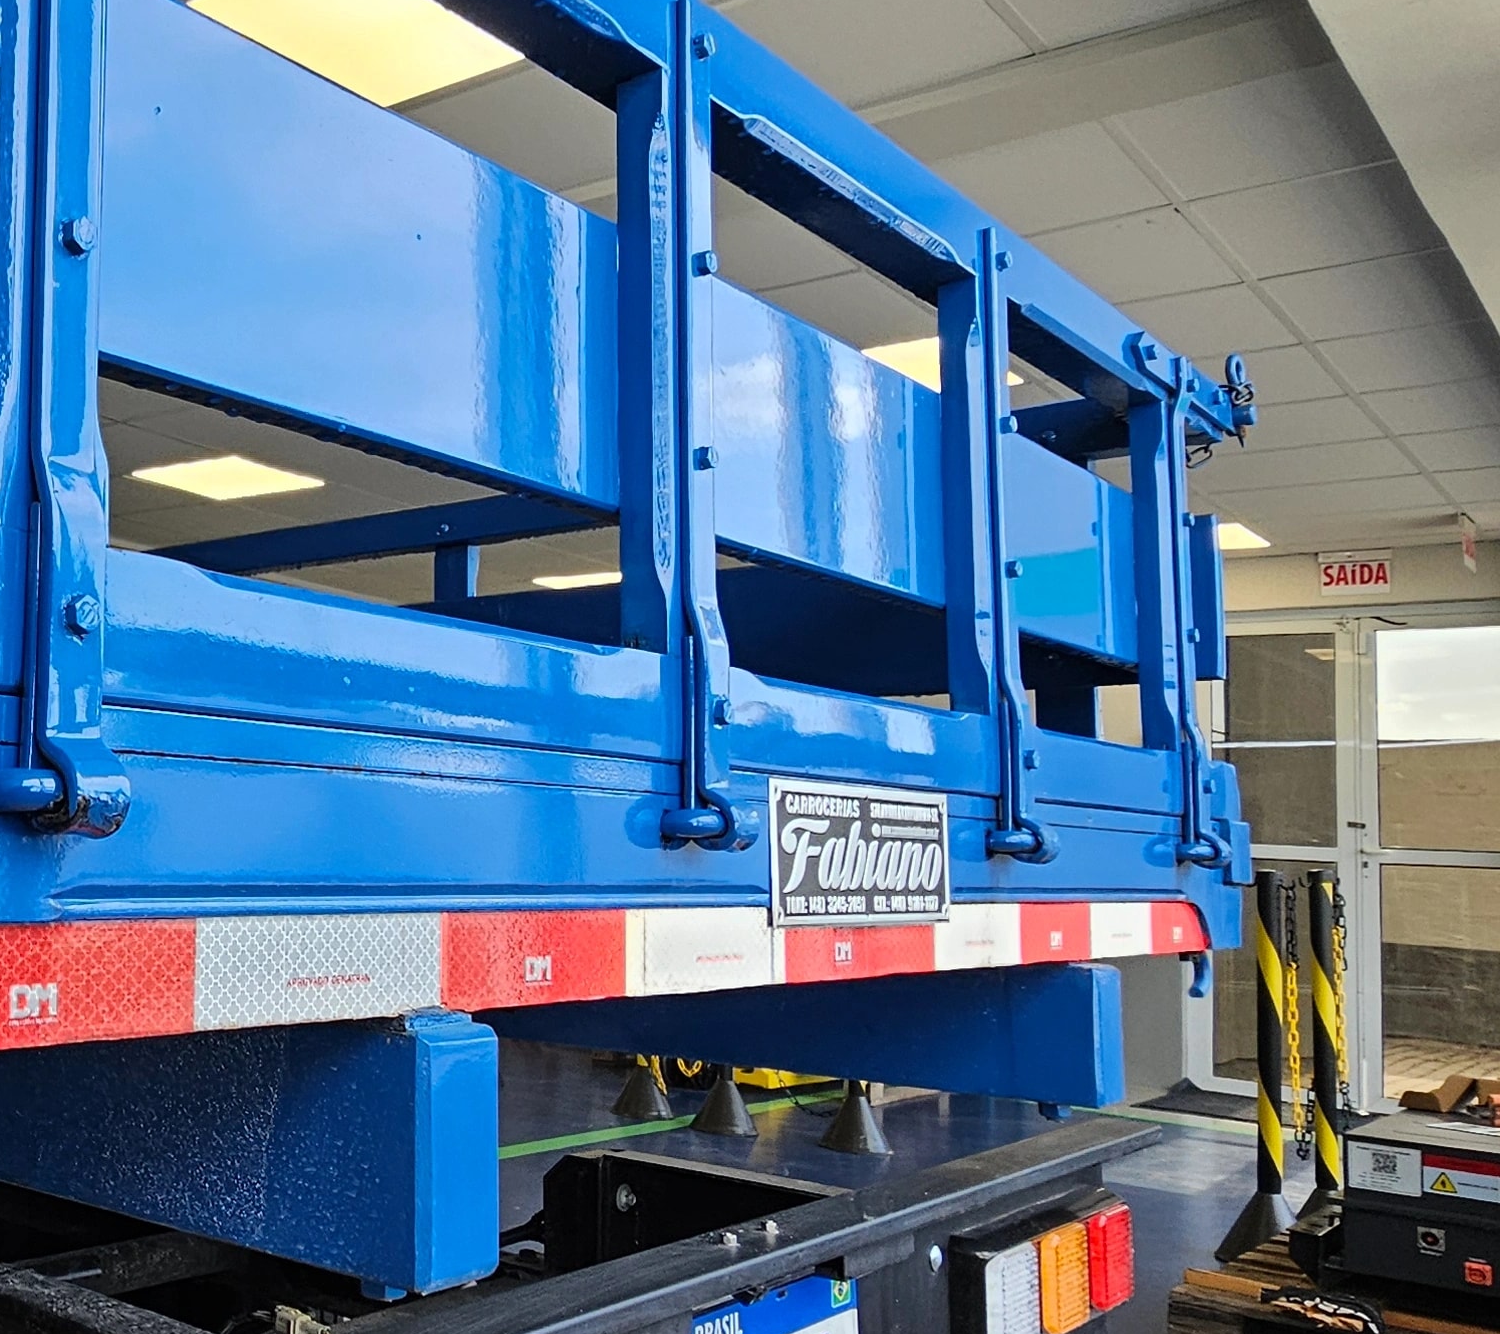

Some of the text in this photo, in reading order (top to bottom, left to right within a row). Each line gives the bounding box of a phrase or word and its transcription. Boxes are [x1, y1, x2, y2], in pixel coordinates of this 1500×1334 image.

[785, 794, 860, 818] CARROCERIAS
[781, 818, 943, 894] Fabiano
[525, 954, 552, 982] DM
[9, 982, 58, 1020] DM
